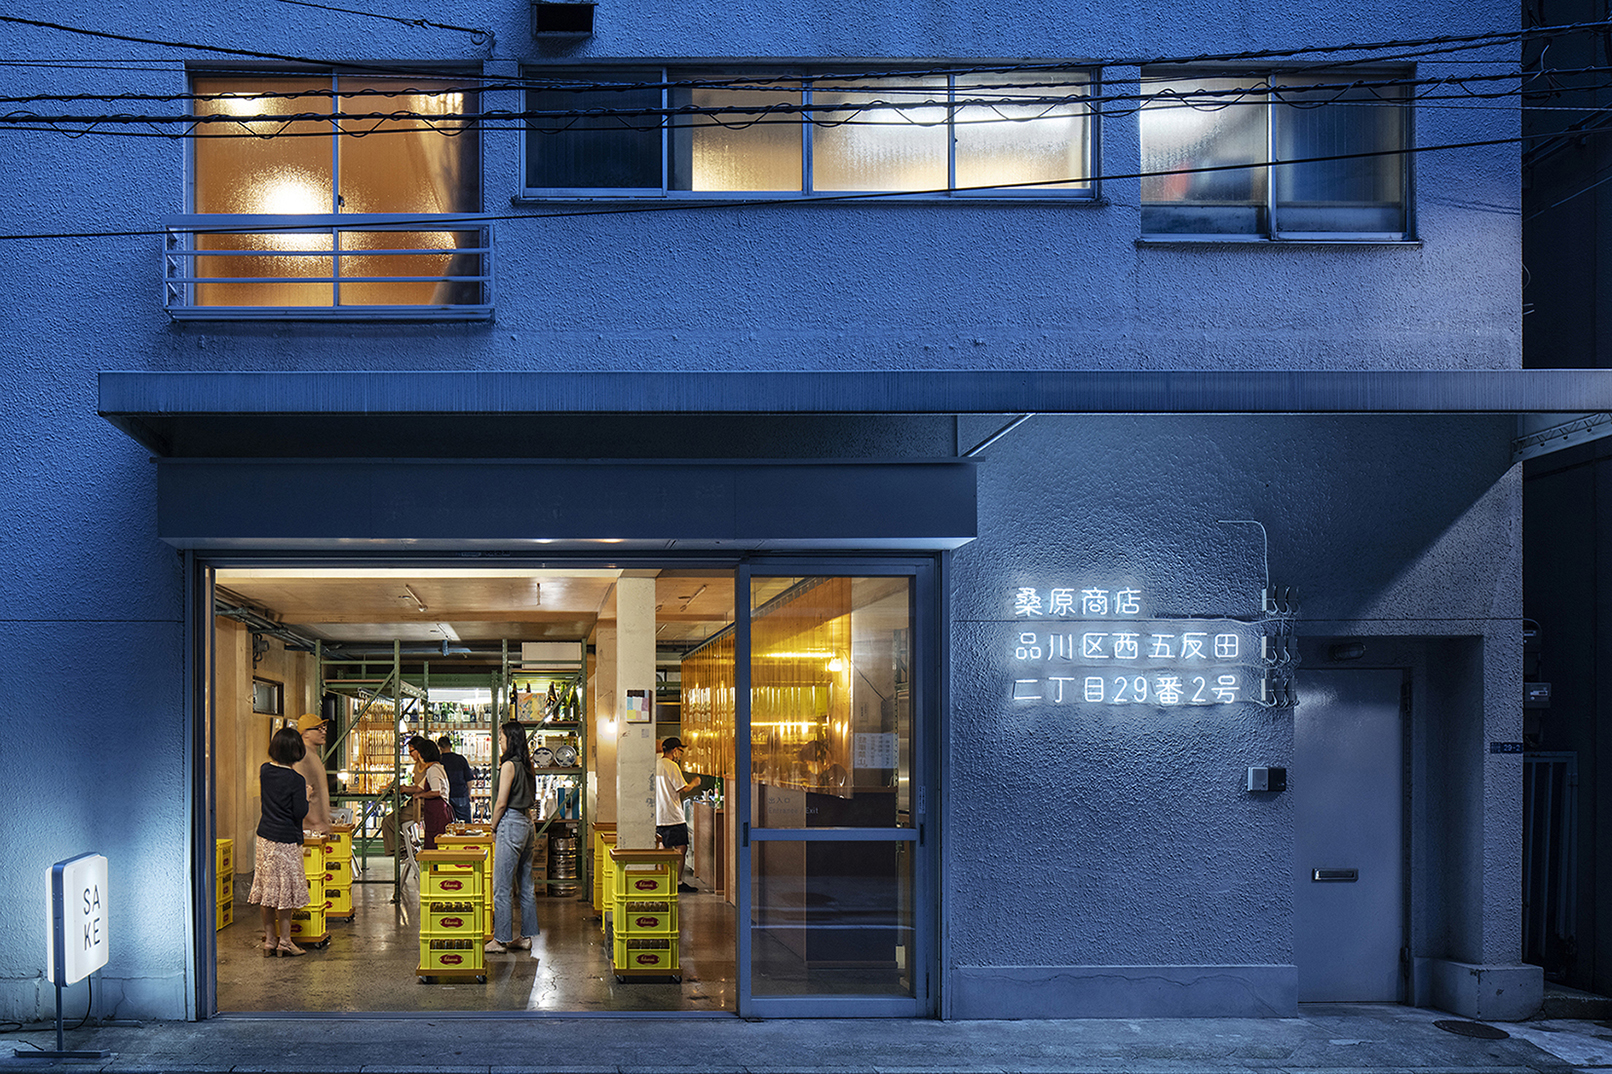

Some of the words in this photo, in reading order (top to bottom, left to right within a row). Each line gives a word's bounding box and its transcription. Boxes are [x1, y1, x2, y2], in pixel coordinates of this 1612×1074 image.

[1015, 587, 1141, 616] 桑原商店
[1015, 632, 1239, 660] 品川区西五反田
[1013, 675, 1239, 704] 二丁目29番2号
[768, 797, 791, 805] 出入口
[806, 806, 819, 814] Exit
[83, 884, 101, 916] SA
[84, 917, 101, 951] KE
